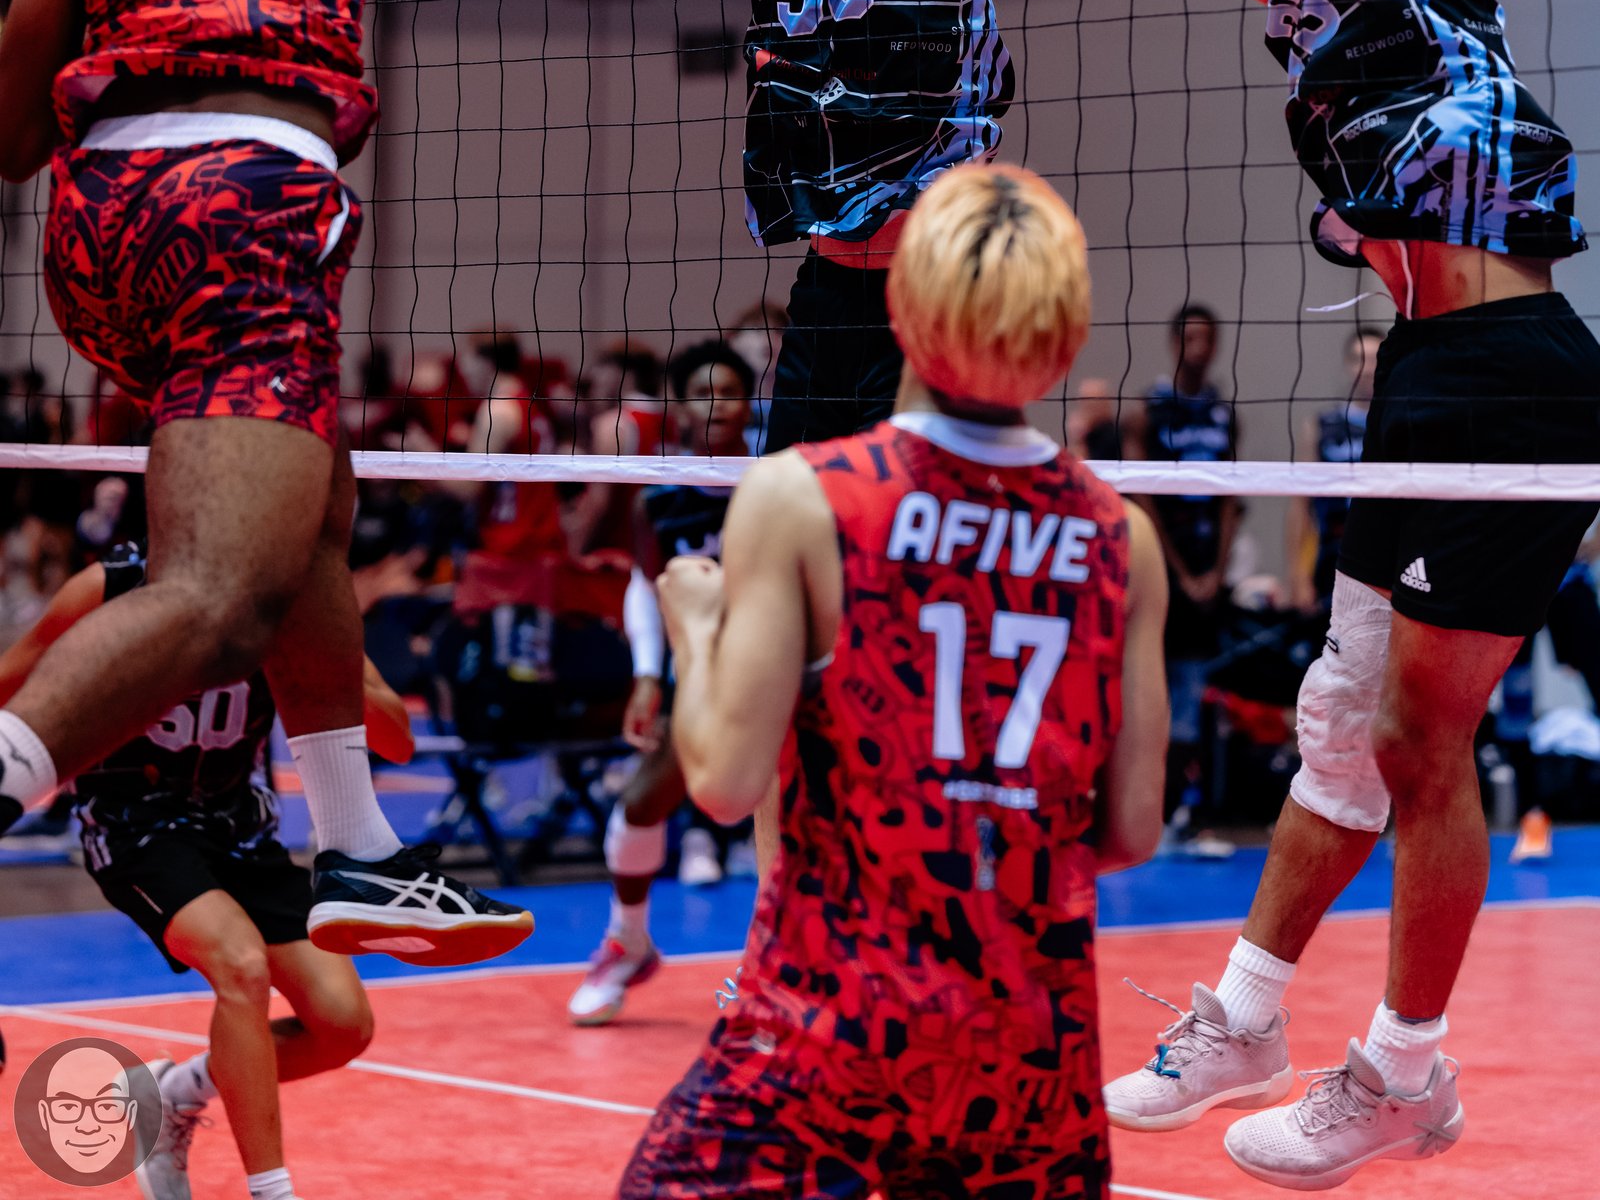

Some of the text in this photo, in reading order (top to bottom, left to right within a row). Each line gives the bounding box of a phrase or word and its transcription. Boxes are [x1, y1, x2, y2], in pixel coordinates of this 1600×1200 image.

[887, 491, 1098, 583] AFIVE
[1400, 573, 1431, 593] adidas
[918, 601, 1071, 769] 17
